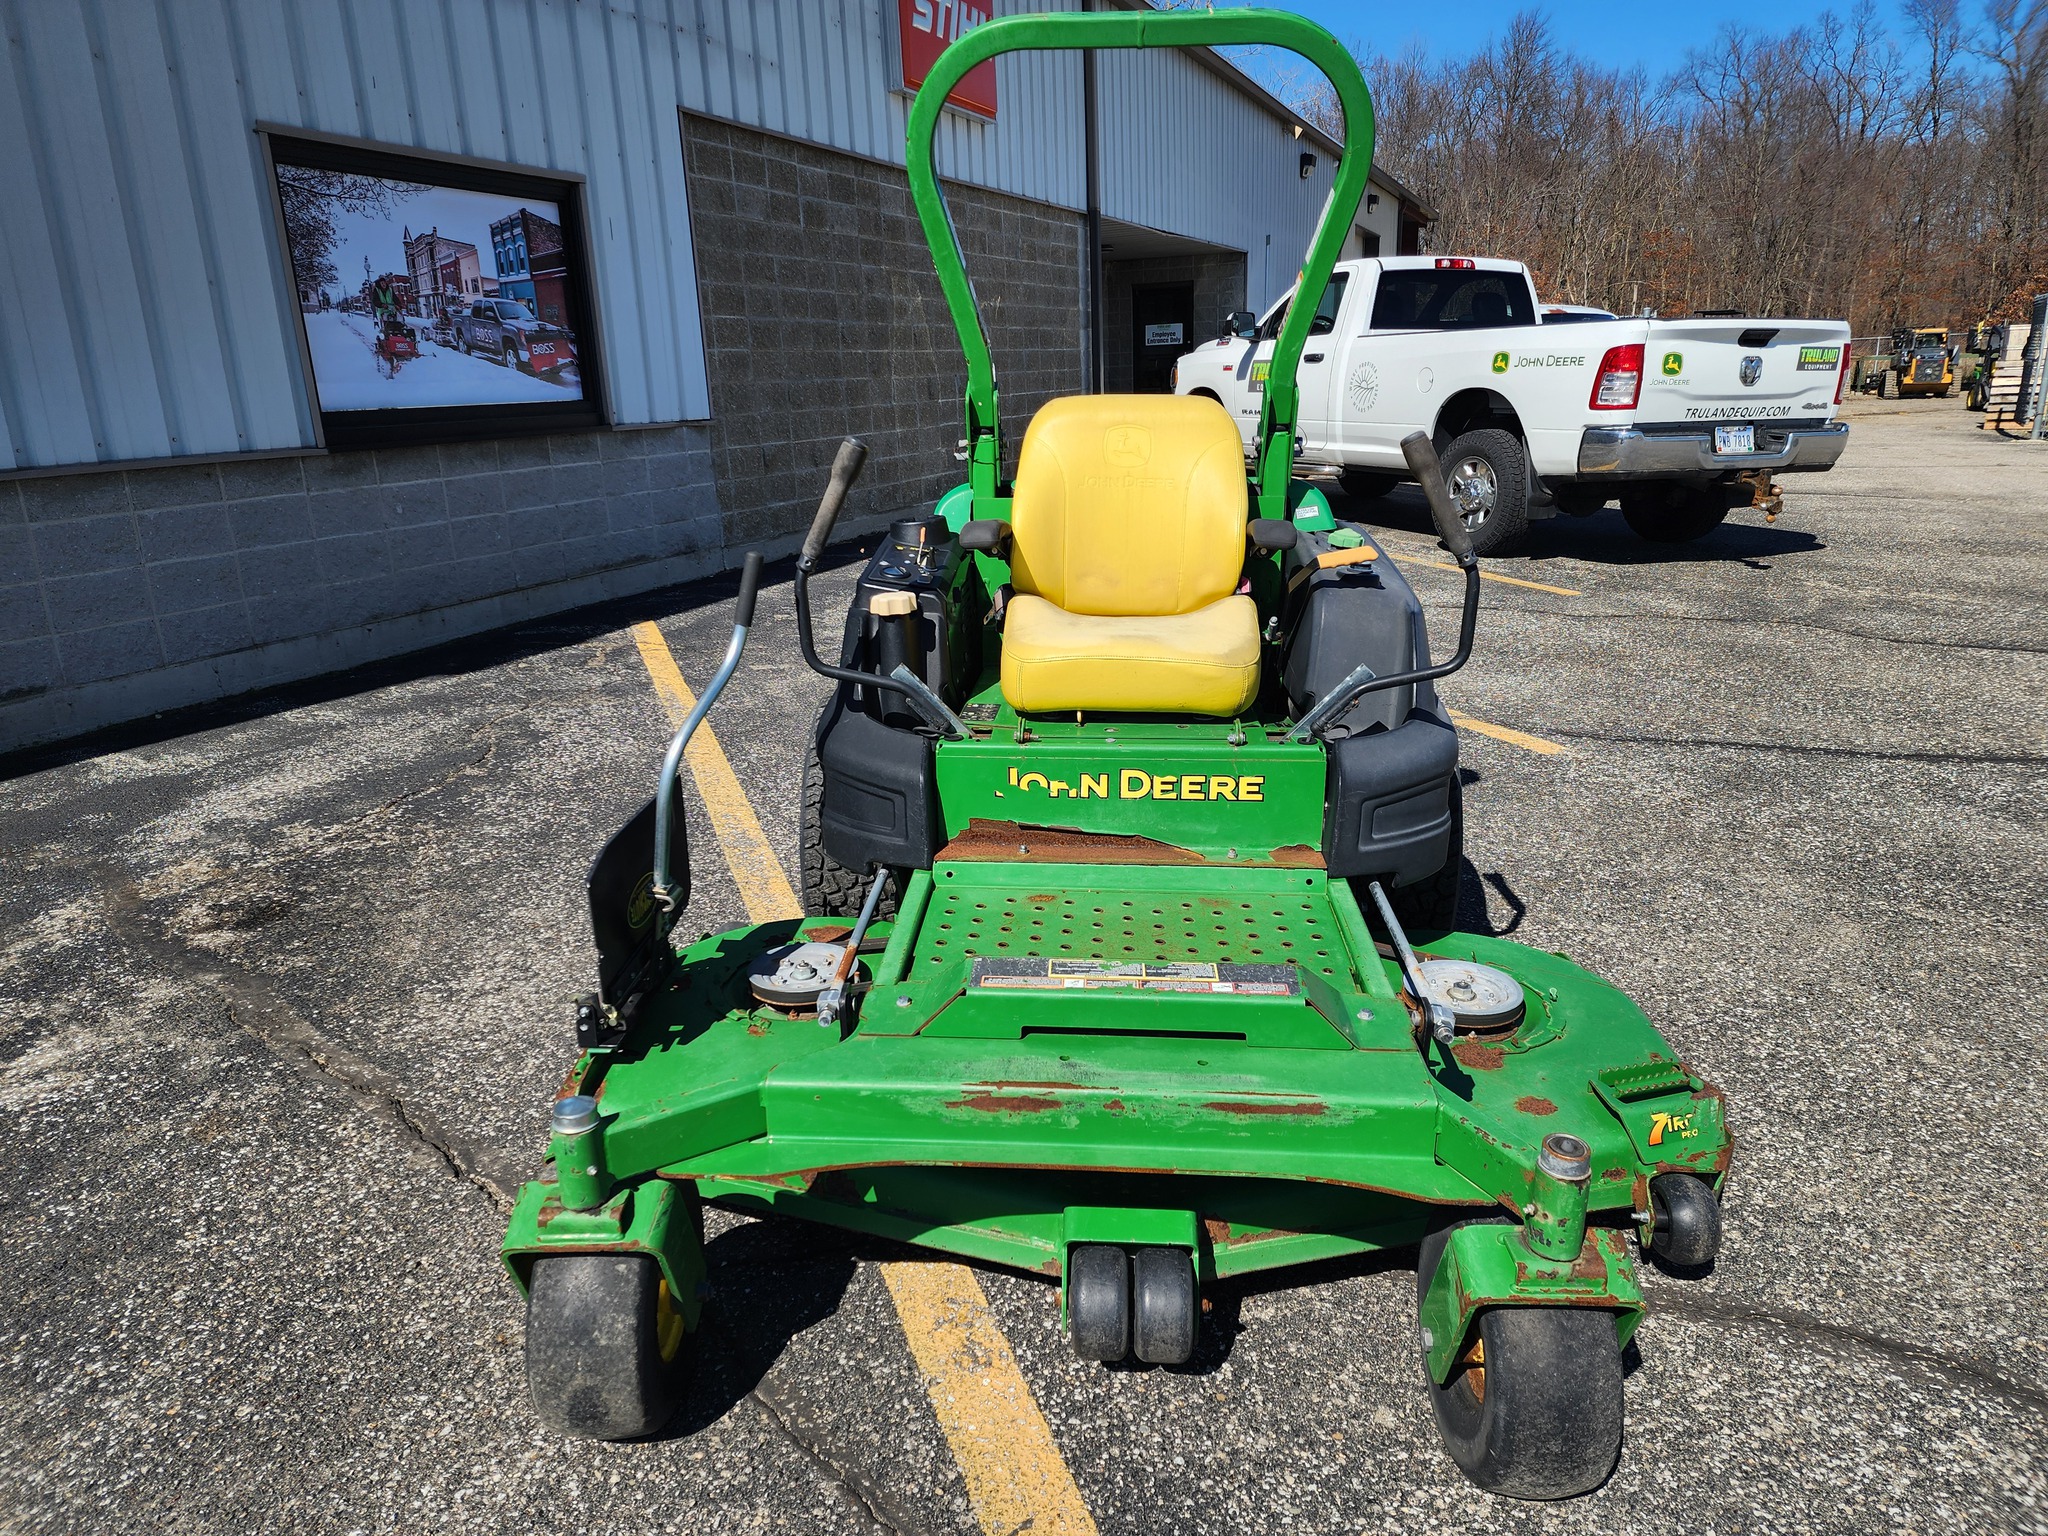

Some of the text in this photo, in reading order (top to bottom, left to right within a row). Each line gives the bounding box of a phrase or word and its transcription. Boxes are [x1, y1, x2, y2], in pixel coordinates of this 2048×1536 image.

[475, 327, 493, 343] BOSS
[531, 342, 555, 355] BOSS
[1514, 354, 1586, 367] JOHN DEERE
[1801, 348, 1839, 363] TRULAND
[1649, 378, 1690, 386] JOHN DEERE
[1685, 406, 1791, 419] TRULANDEQUIP.COM
[1078, 475, 1175, 489] JOHN DEERE
[1120, 768, 1265, 801] DEERE
